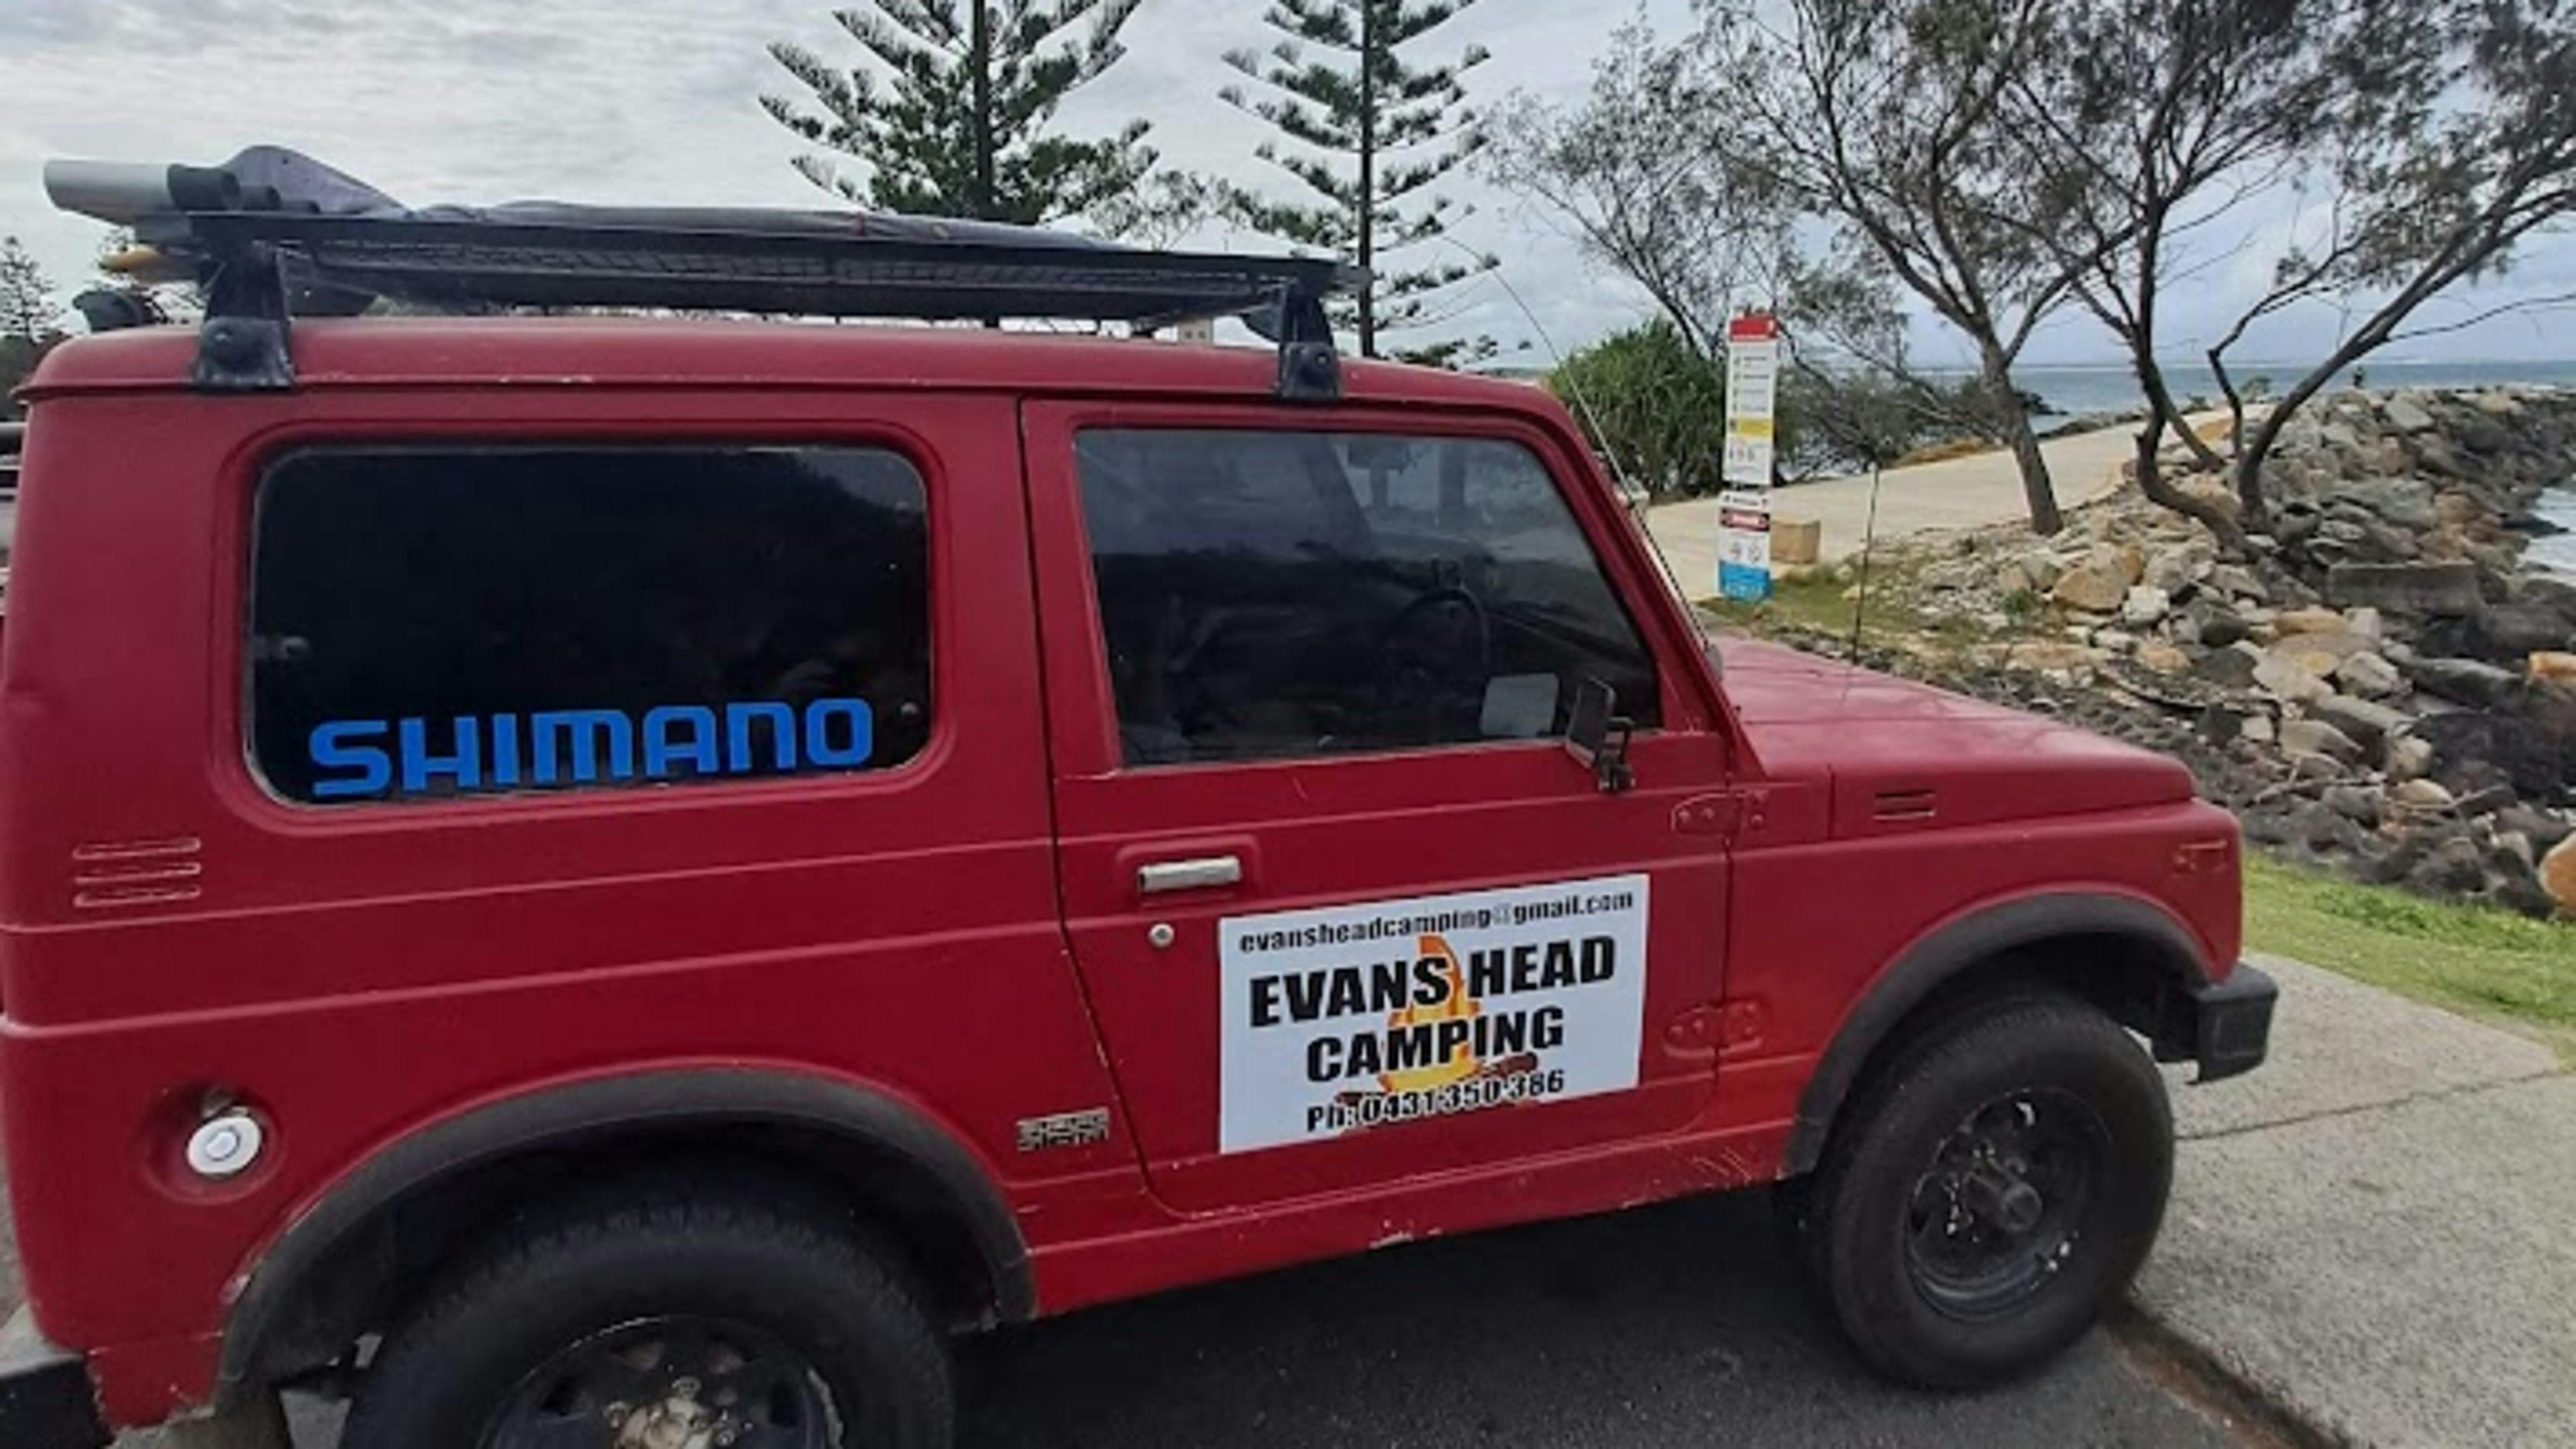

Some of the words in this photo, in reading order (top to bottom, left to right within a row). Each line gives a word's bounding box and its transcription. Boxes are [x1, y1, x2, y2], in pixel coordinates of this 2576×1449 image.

[309, 698, 873, 796] SHIMANO
[1240, 891, 1633, 953] evansheadcamping@gmail.com
[1249, 955, 1448, 1028] EVANS
[1468, 936, 1615, 998] HEAD
[1306, 1006, 1564, 1083] CAMPING
